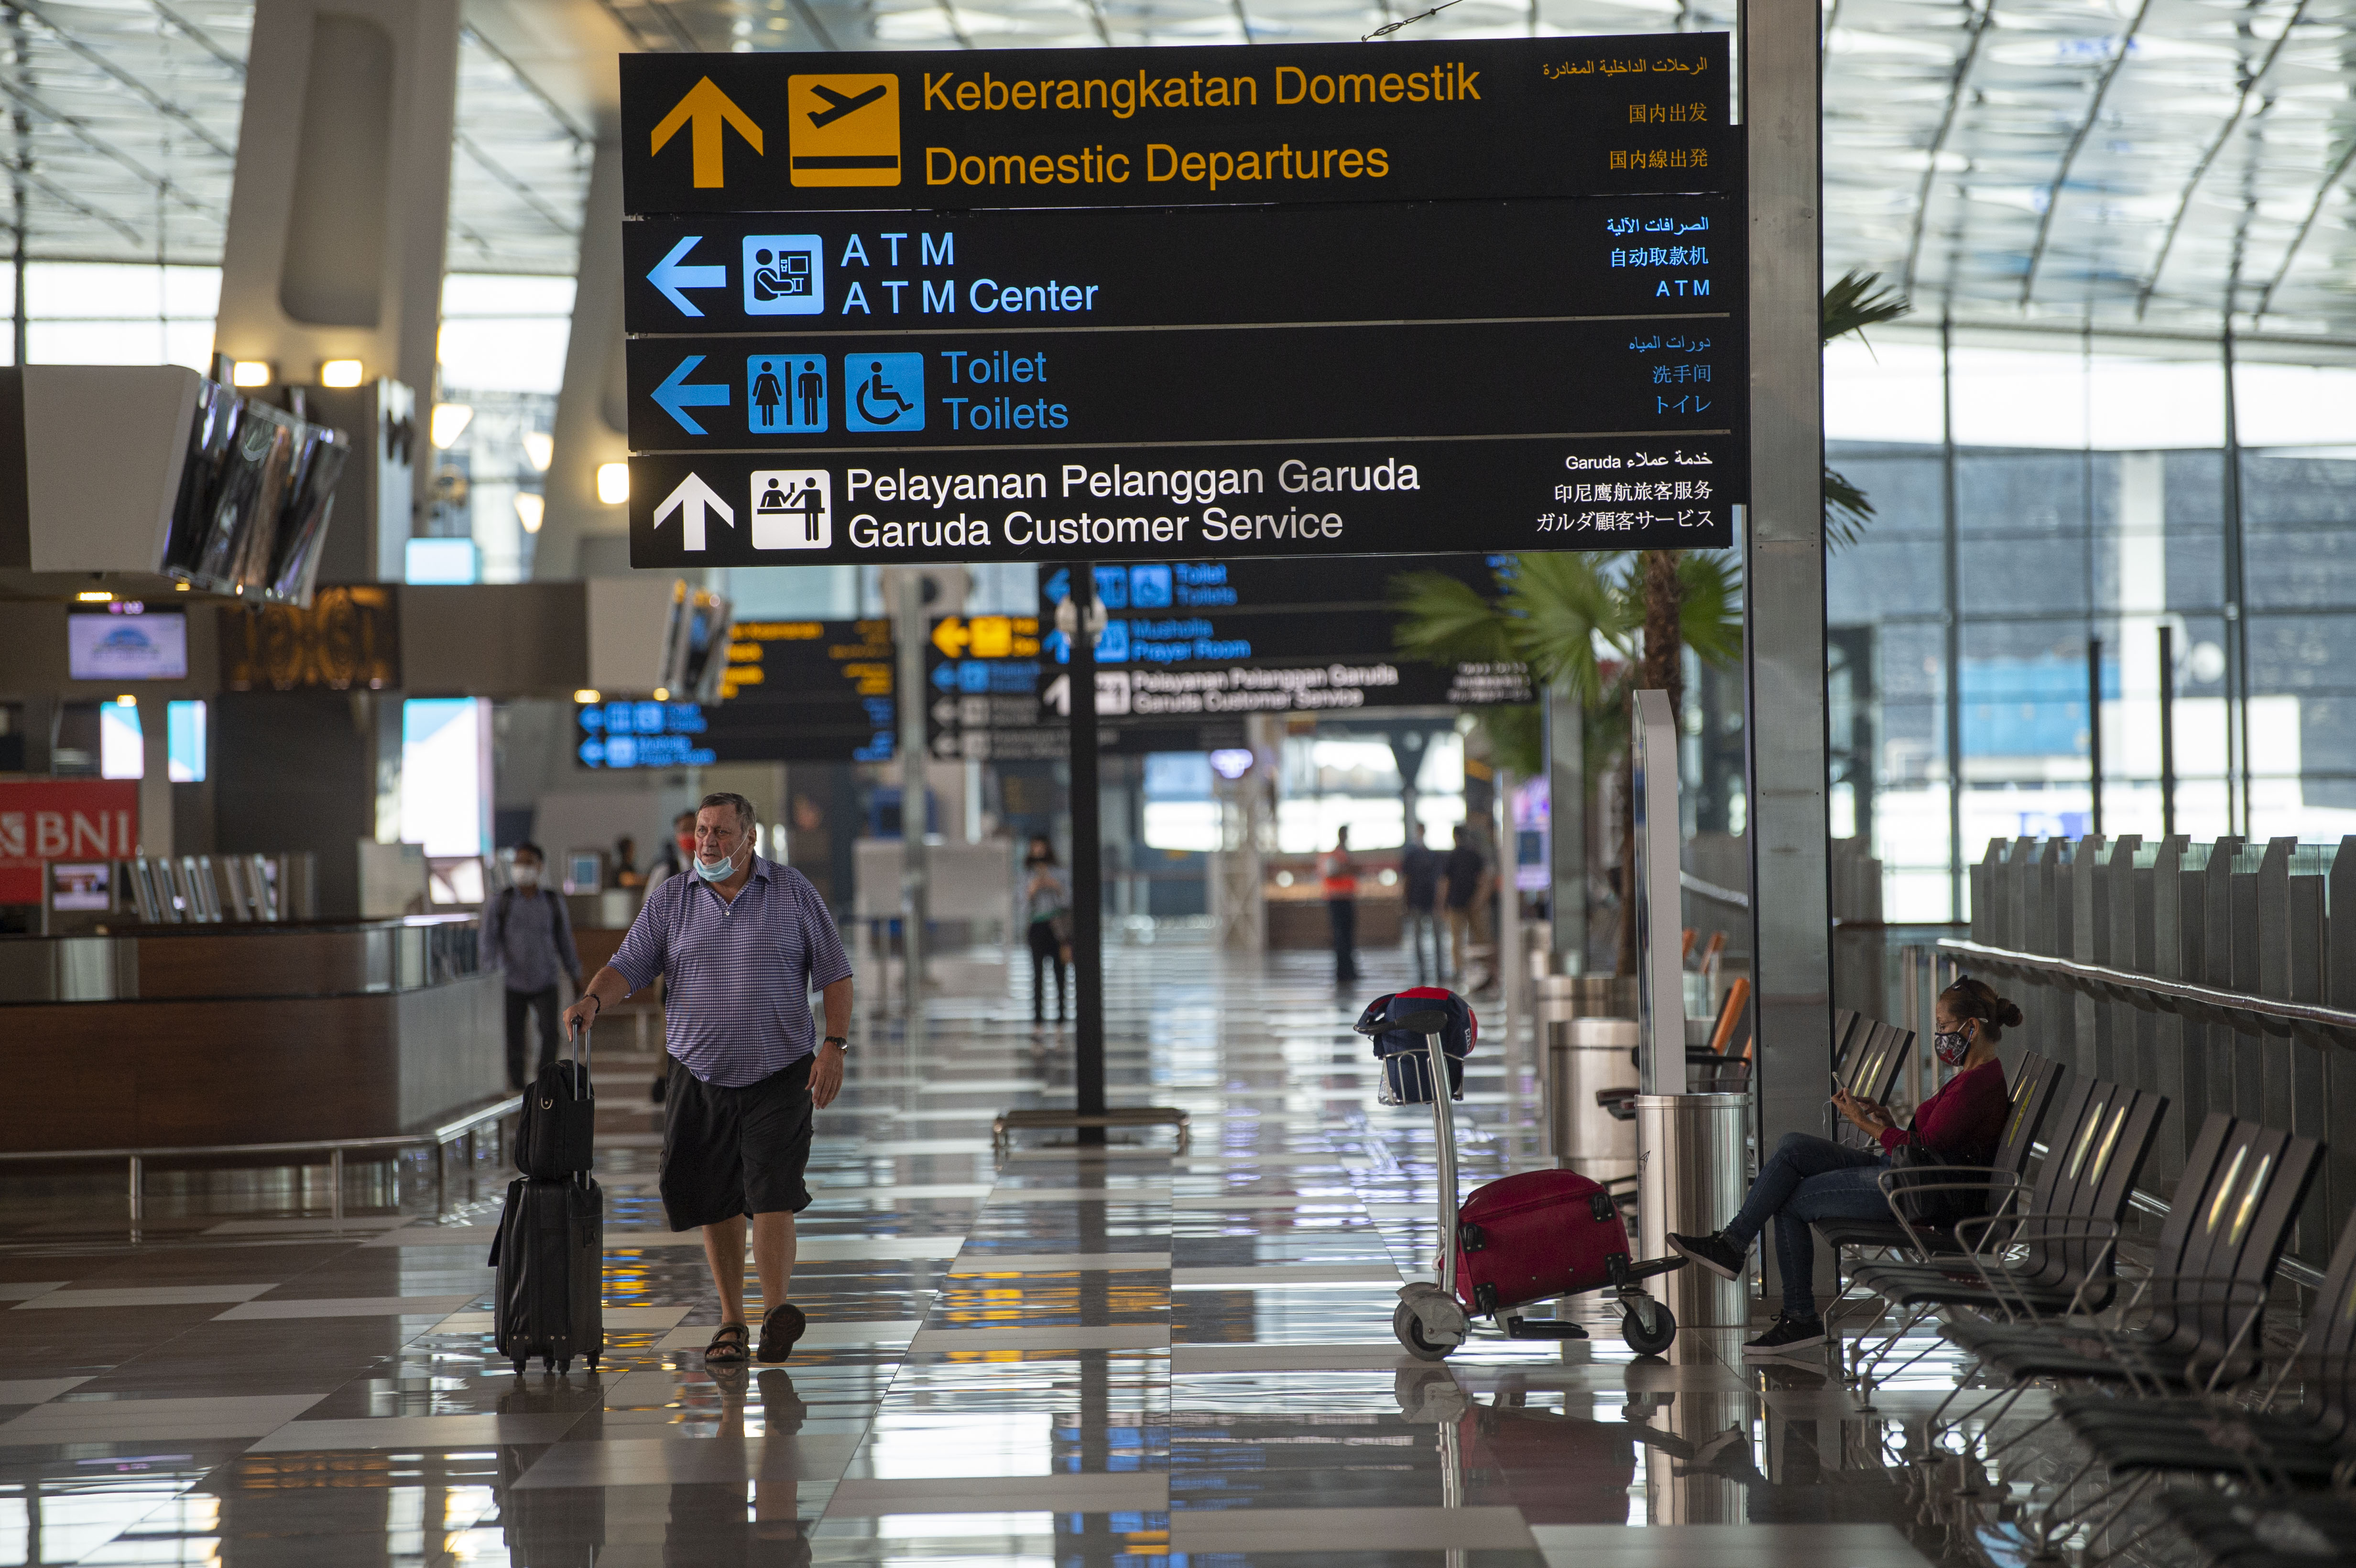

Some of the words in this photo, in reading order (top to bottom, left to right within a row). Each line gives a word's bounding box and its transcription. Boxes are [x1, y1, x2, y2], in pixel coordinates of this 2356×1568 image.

[1544, 61, 1594, 79] المغادرة
[1600, 59, 1646, 76] الداخلية
[1652, 57, 1707, 75] الرحلات
[925, 70, 1256, 118] Keberangkatan
[1276, 63, 1481, 104] Domestik
[1630, 103, 1707, 123] 国内出发
[926, 145, 1129, 185] Domestic
[1147, 144, 1388, 190] Departures
[1611, 149, 1707, 169] 国内線出発
[1611, 246, 1709, 268] 自动取款机
[970, 279, 1098, 313] Center
[1629, 336, 1660, 352] المياه
[1667, 336, 1710, 352] دورات
[941, 351, 1047, 383] Toilet
[1653, 365, 1710, 383] 洗手间
[943, 397, 1068, 430] Toilets
[1658, 395, 1711, 414] トイレ
[1566, 455, 1621, 469] Garuda
[1627, 452, 1669, 468] عملاء
[1675, 450, 1712, 465] خدمة
[848, 468, 1046, 509] Pelayanan
[1063, 464, 1263, 504] Pelanggan
[1279, 458, 1420, 492] Garuda
[1555, 480, 1712, 503] 印尼鹰航旅客服务
[849, 513, 991, 547] Garuda
[1004, 512, 1189, 544] Customer
[1202, 507, 1342, 540] Service
[1537, 509, 1713, 531] ガルダ顧客サービス
[35, 810, 129, 857] BNI
